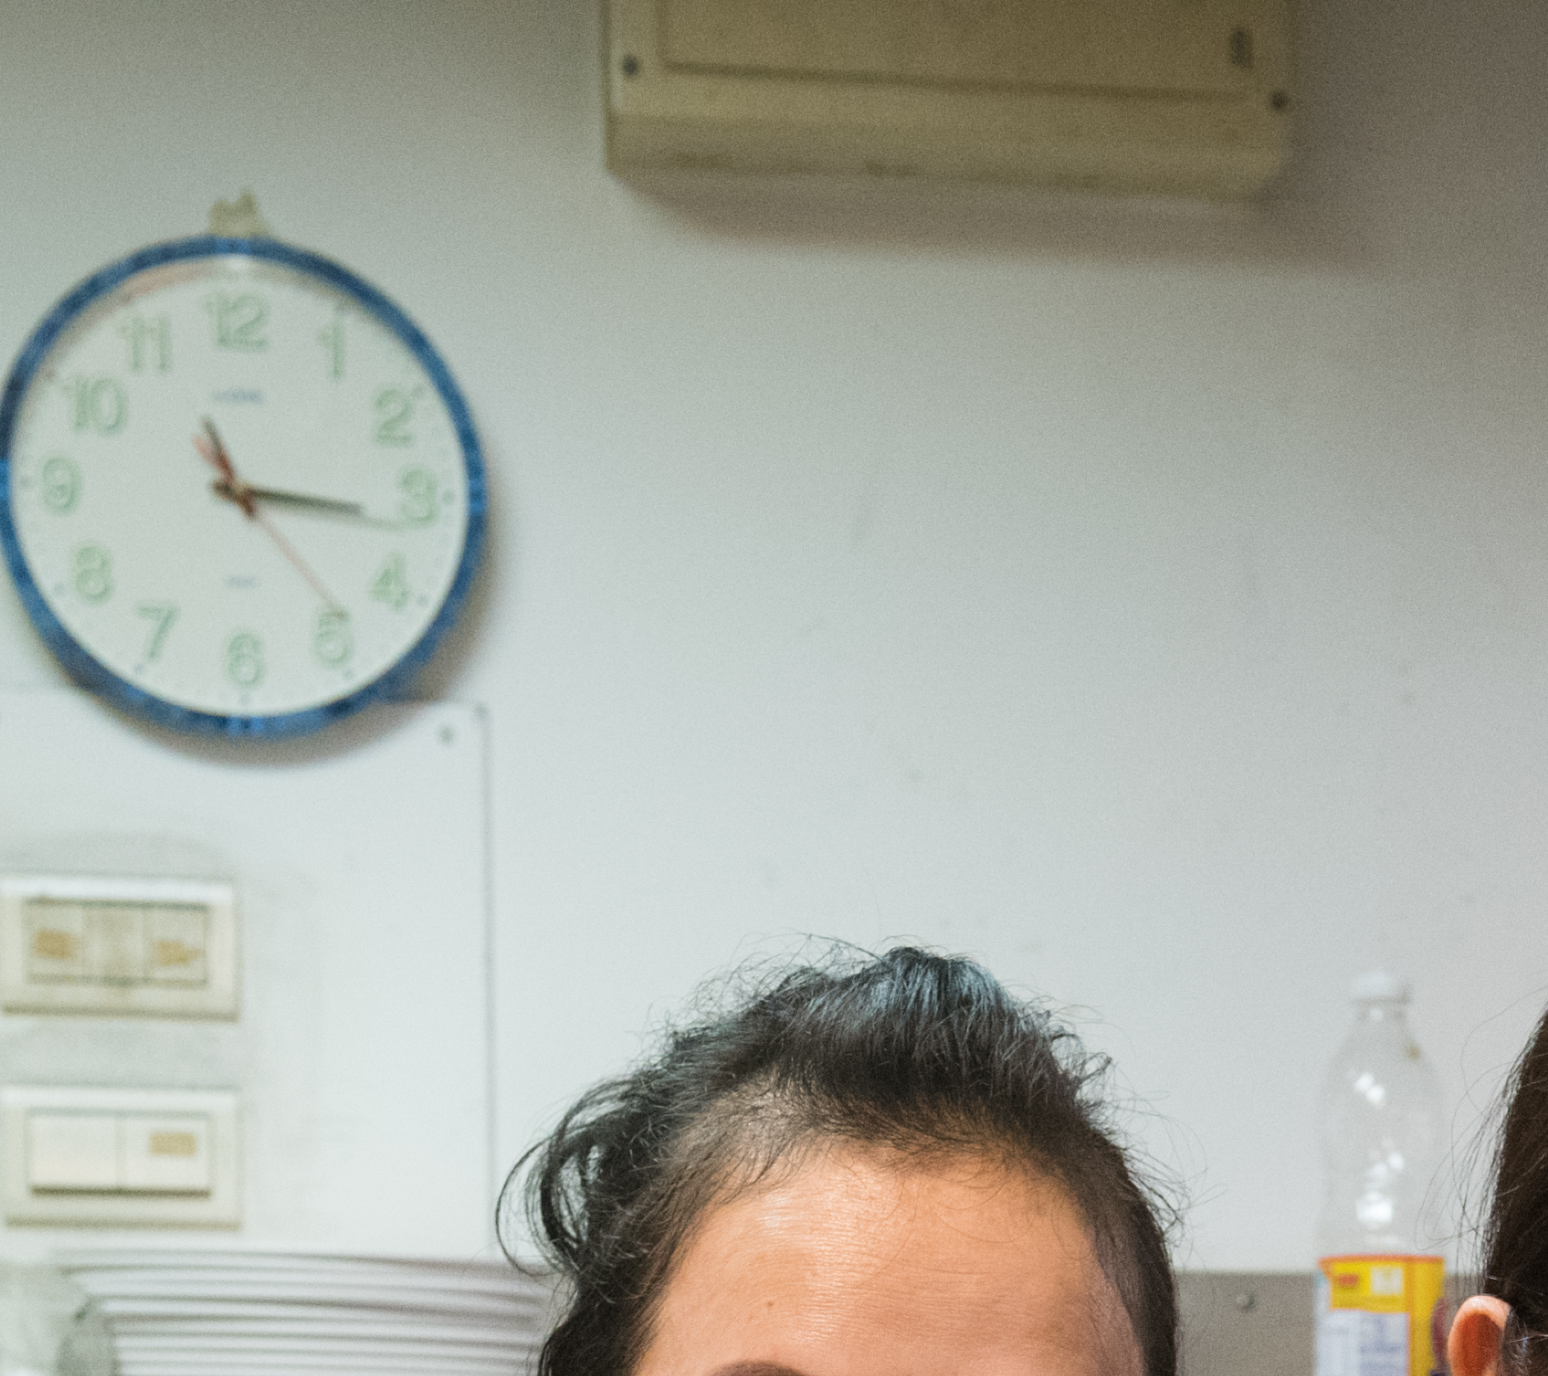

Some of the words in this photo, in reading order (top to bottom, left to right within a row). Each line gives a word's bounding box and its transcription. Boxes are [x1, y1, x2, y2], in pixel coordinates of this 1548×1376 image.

[116, 315, 172, 373] 11
[206, 293, 269, 351] 12
[318, 322, 345, 379] 1
[62, 376, 129, 436] 10
[374, 386, 414, 446] 2
[42, 457, 82, 516] 9
[402, 468, 438, 529] 3
[73, 546, 112, 604] 8
[369, 553, 412, 612] 4
[137, 603, 180, 662] 7
[228, 632, 265, 688] 6
[315, 608, 352, 668] 5
